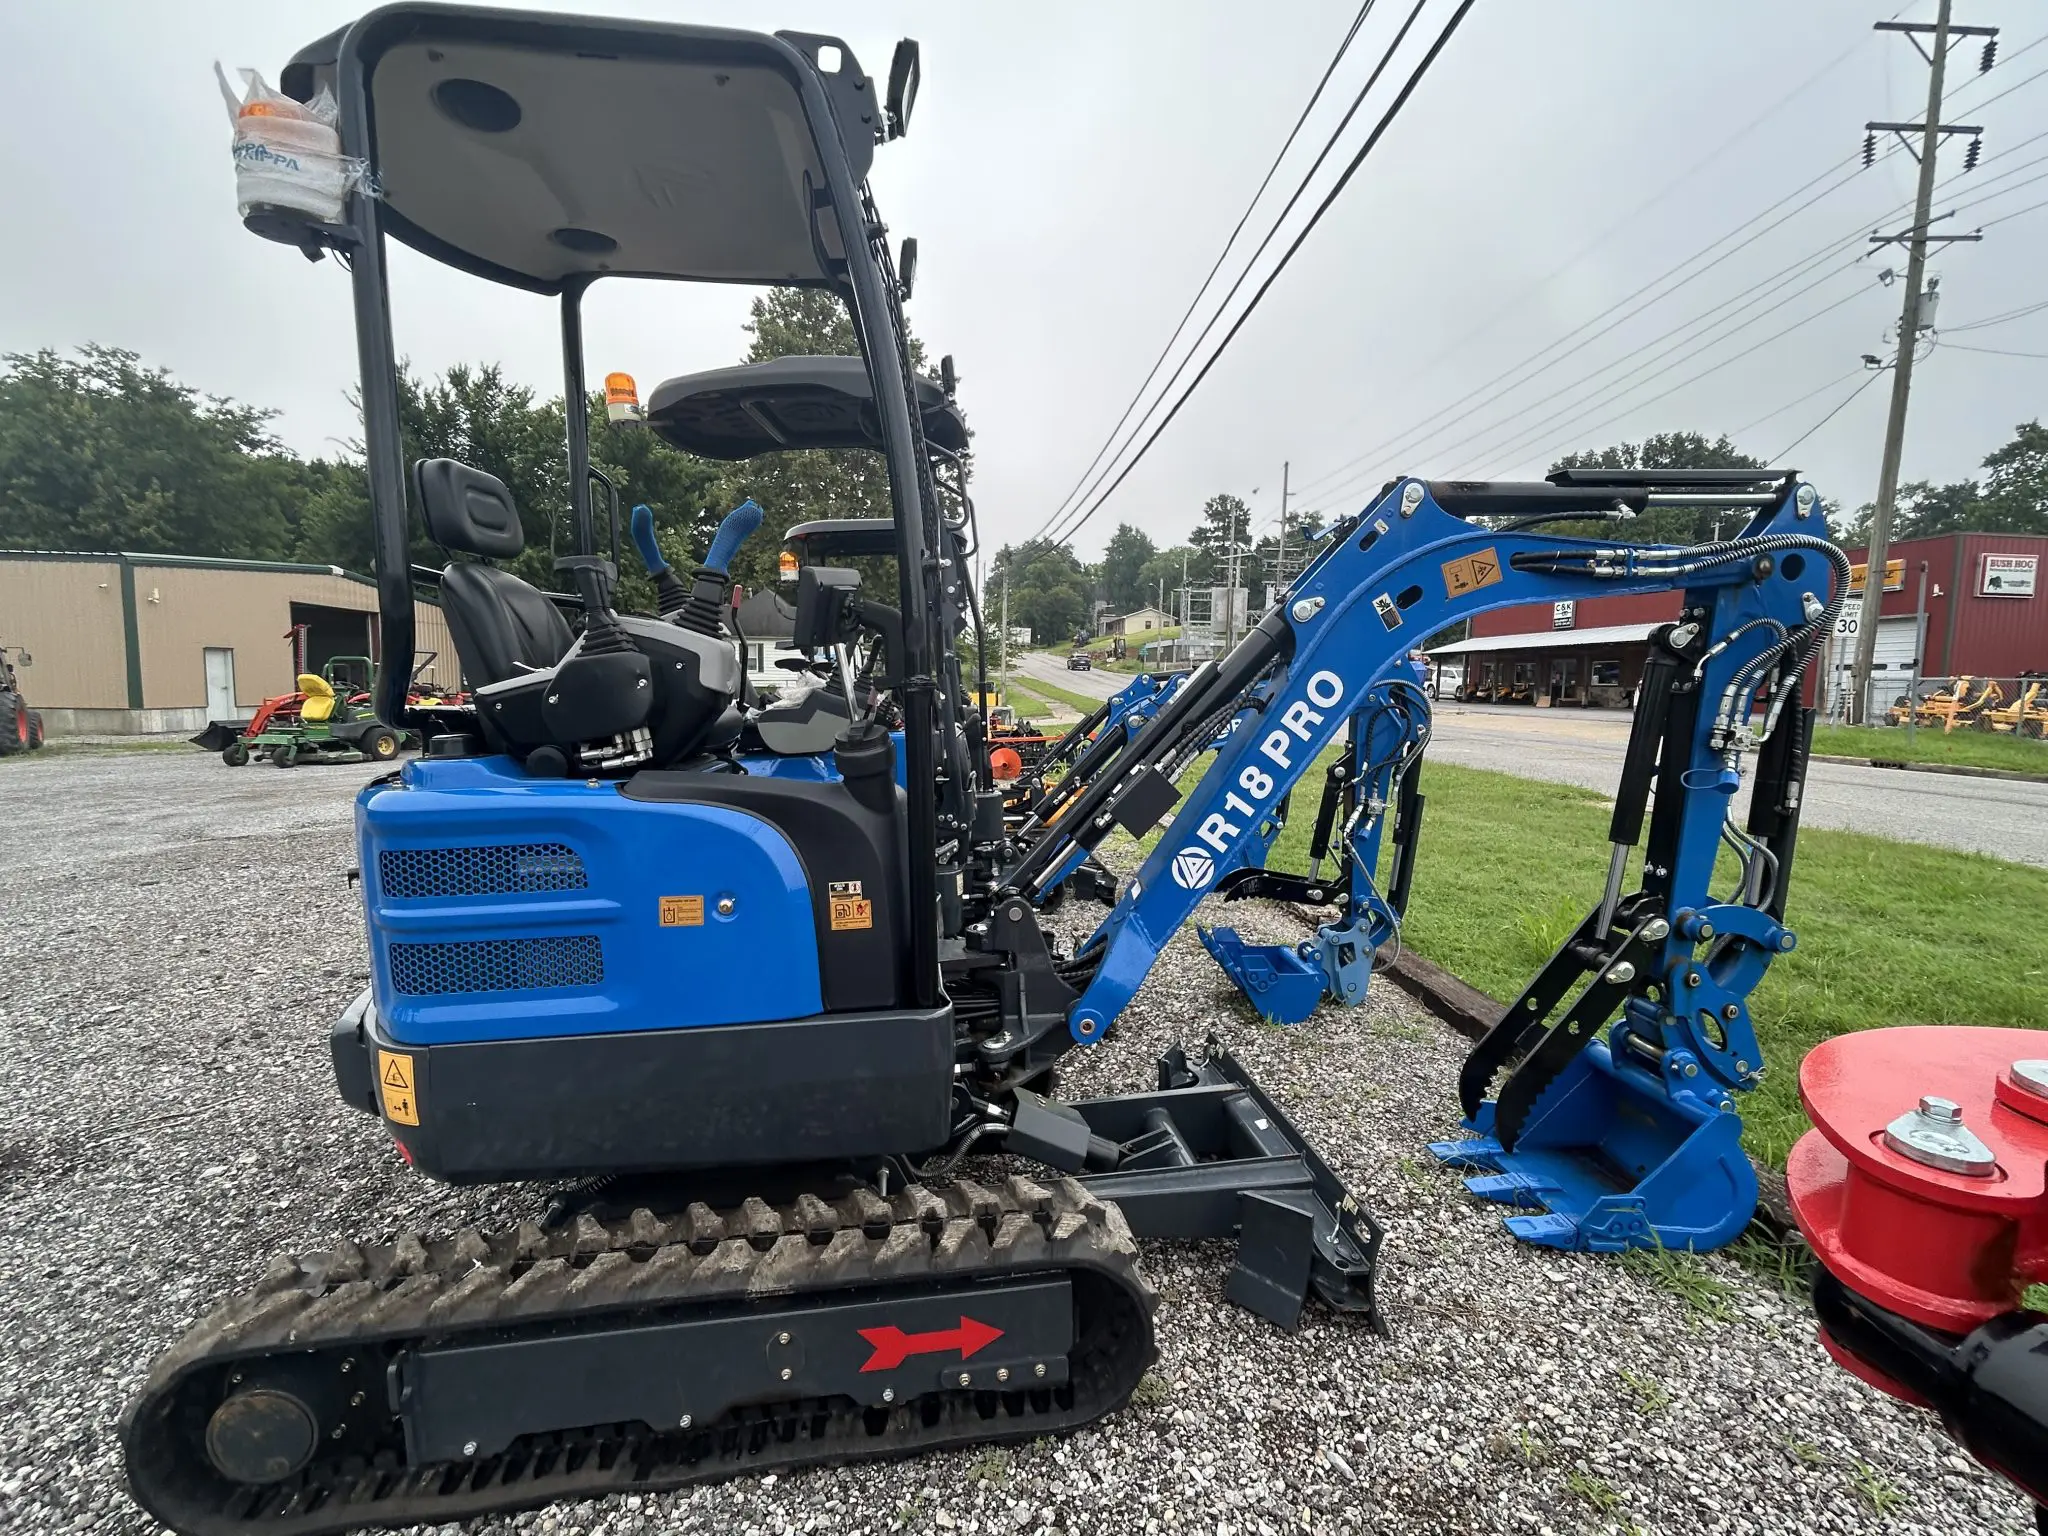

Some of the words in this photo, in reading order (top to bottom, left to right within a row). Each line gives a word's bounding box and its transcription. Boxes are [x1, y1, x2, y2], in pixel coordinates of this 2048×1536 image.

[1990, 559, 2013, 568] BUSH
[2014, 559, 2034, 569] HOG
[1843, 603, 1861, 611] PEED
[1837, 619, 1858, 634] 30
[1196, 765, 1274, 853] R18
[1259, 670, 1344, 770] PRO
